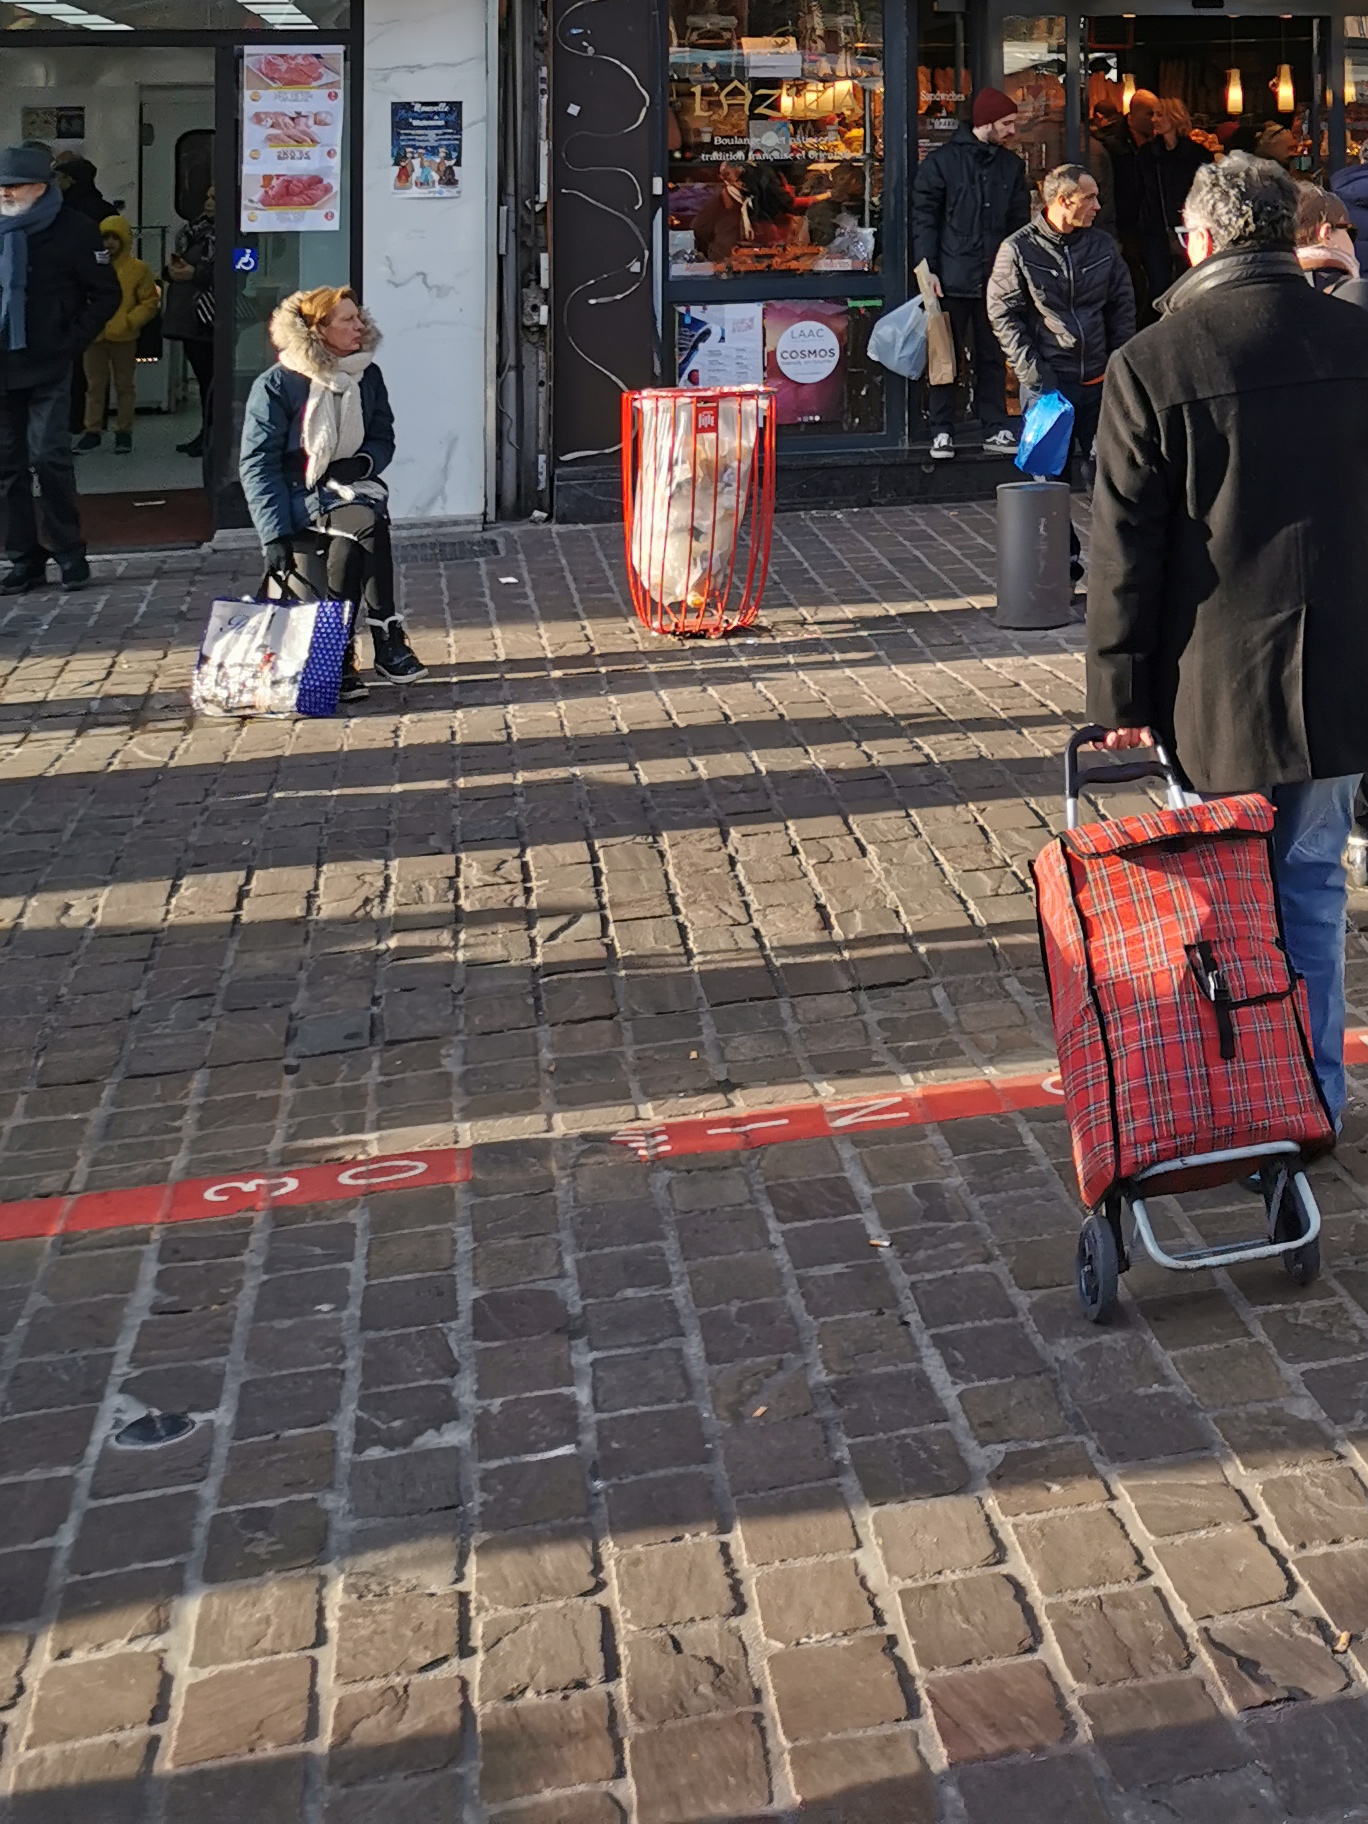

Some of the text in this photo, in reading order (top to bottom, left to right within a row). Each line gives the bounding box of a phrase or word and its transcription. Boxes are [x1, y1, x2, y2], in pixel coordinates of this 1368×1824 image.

[701, 151, 746, 162] tradition
[790, 328, 825, 340] LAAC
[780, 348, 836, 361] COSMOS
